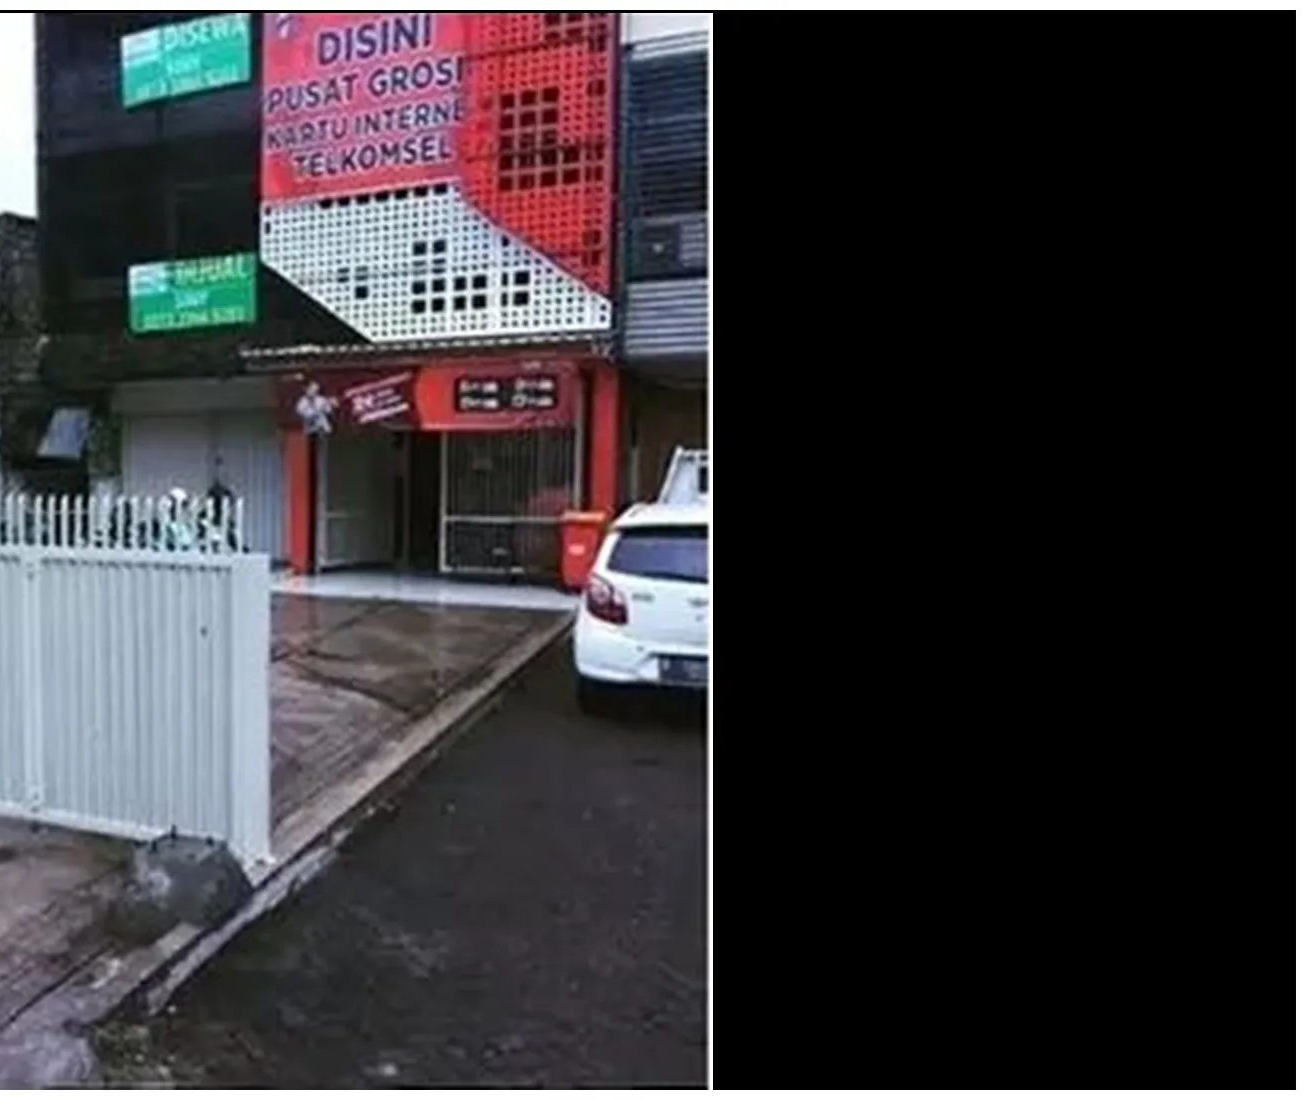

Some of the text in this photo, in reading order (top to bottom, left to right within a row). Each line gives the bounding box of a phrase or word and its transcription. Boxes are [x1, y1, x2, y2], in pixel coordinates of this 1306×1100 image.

[317, 13, 431, 65] DISINI
[267, 73, 359, 113] PUSAT
[267, 118, 348, 150] KARTU
[294, 136, 452, 177] TELKOMSEL
